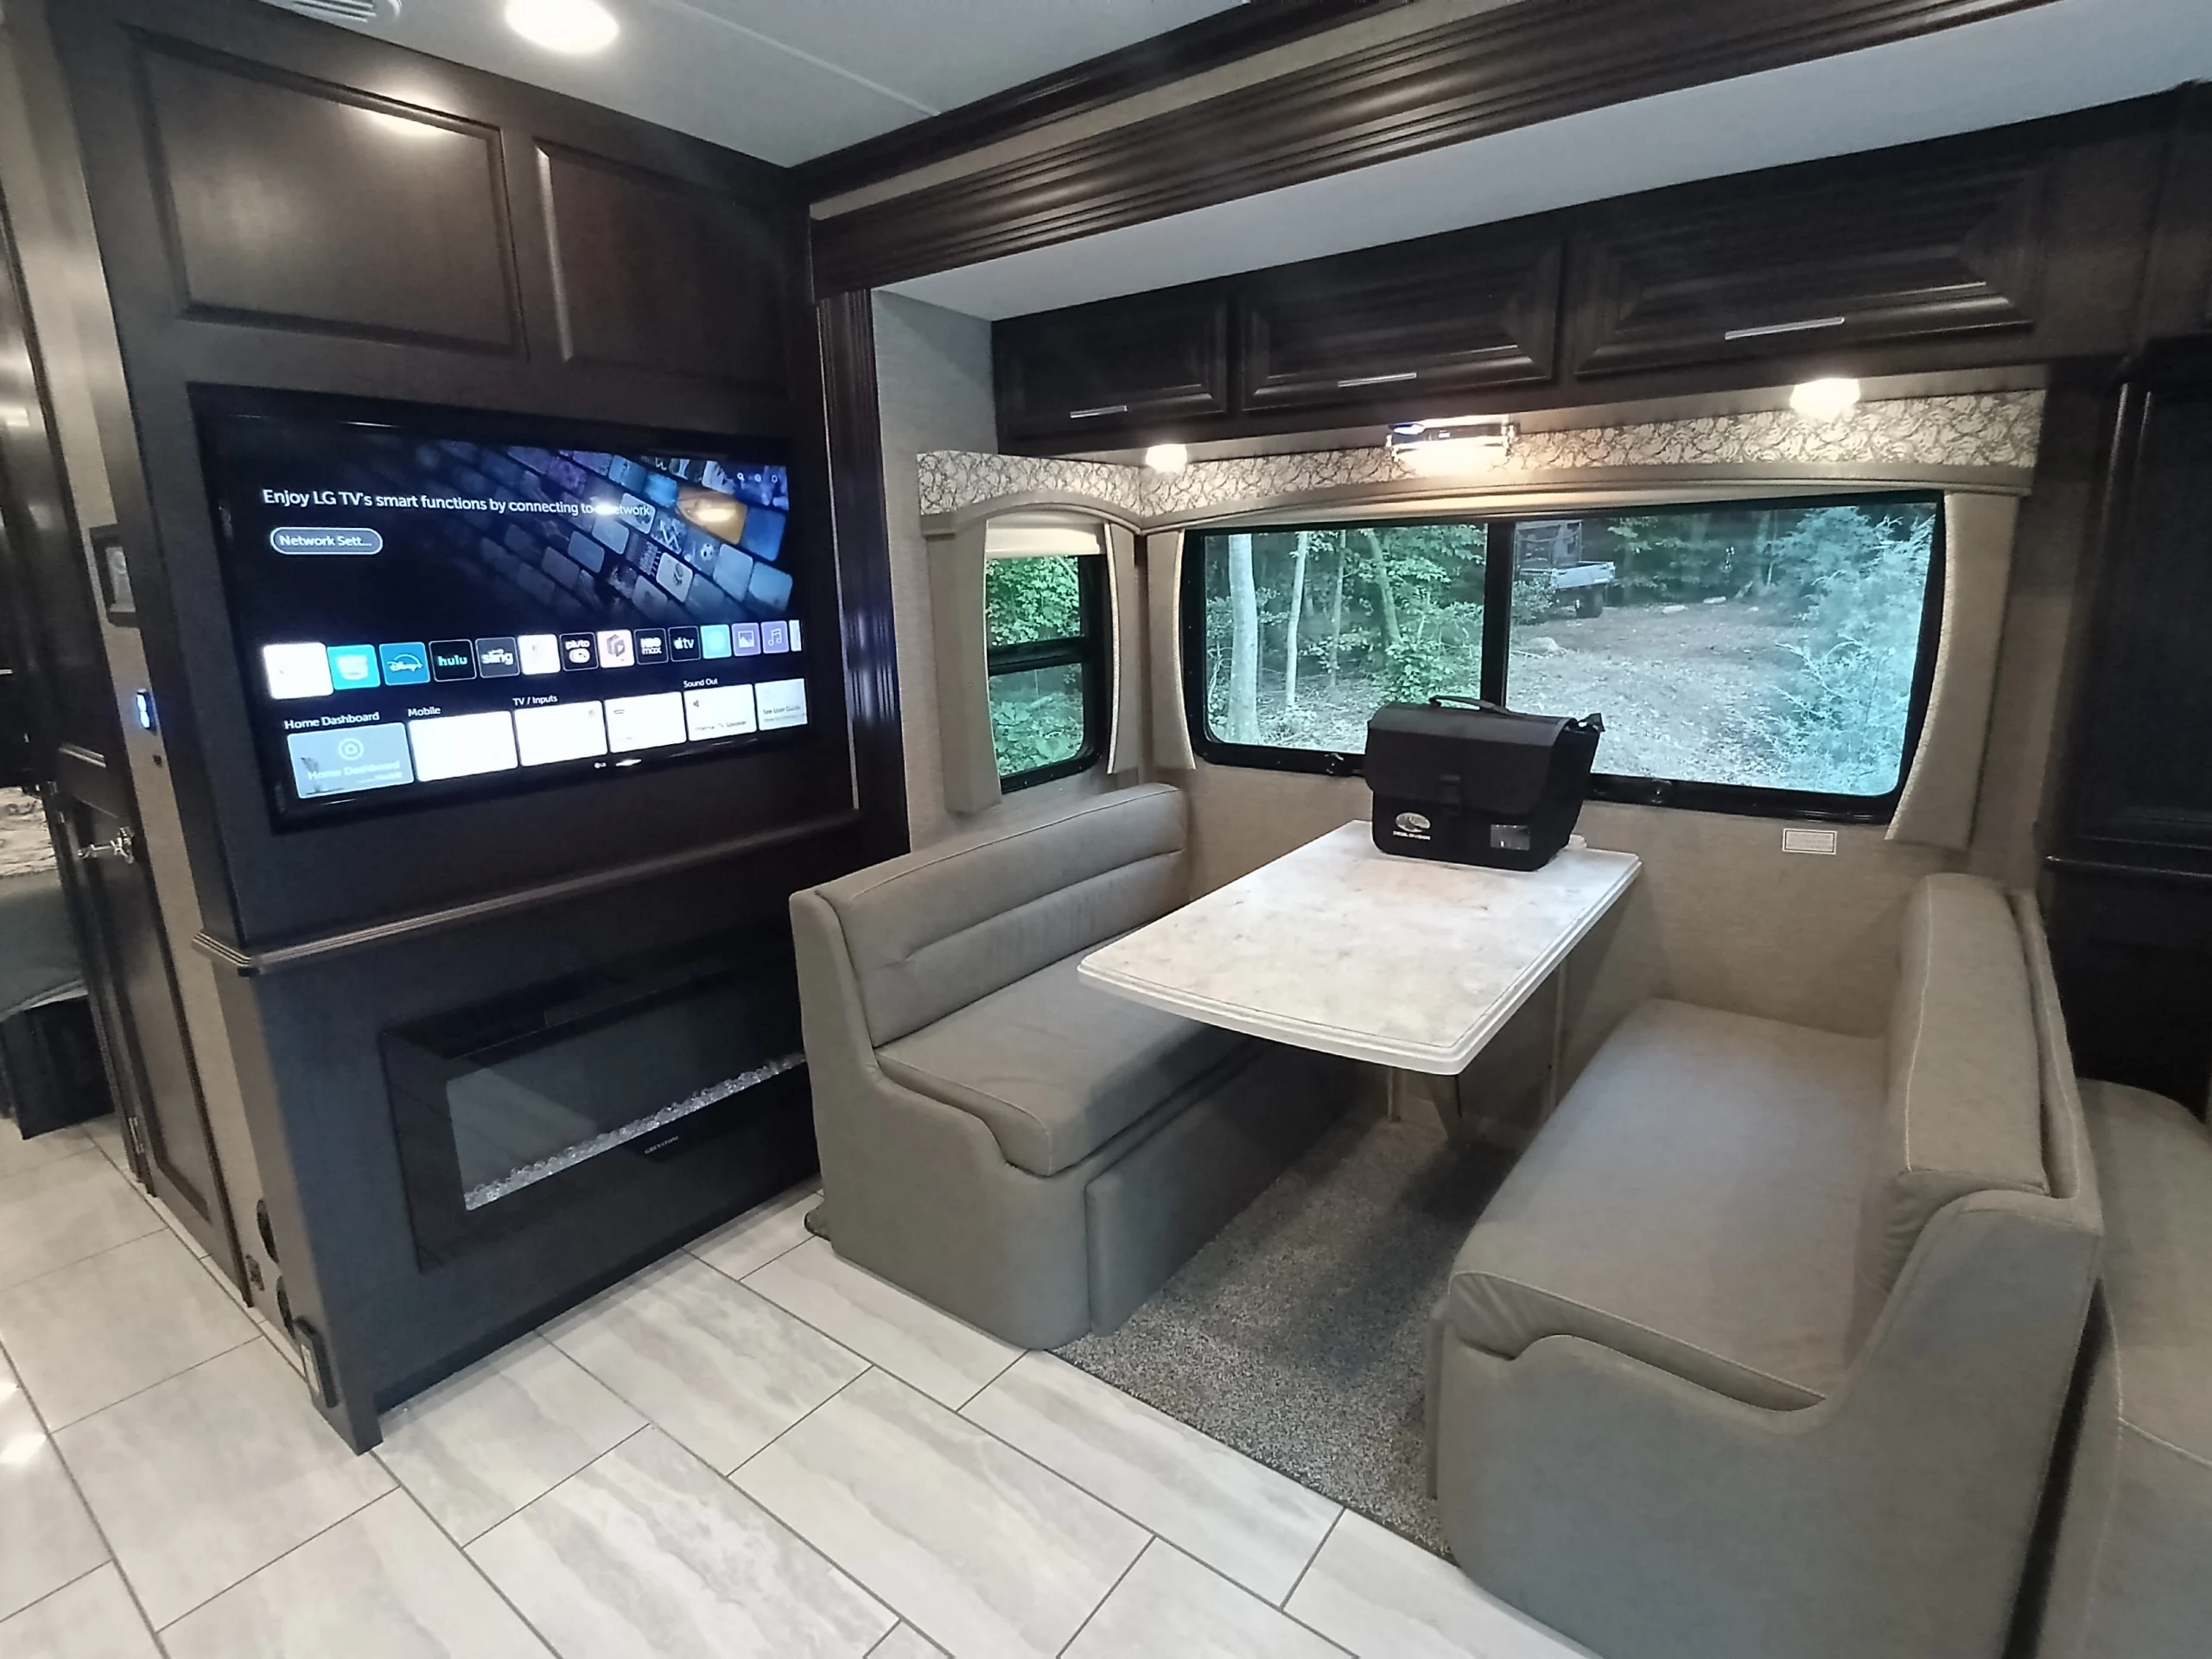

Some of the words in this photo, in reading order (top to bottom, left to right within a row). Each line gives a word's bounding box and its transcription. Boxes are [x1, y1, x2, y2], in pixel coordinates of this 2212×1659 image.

[263, 489, 309, 507] Enjoy
[313, 491, 337, 505] LG
[338, 491, 373, 506] TV's
[376, 495, 418, 508] smart
[421, 495, 488, 511] functions
[489, 498, 506, 514] by
[508, 499, 579, 516] connecting
[581, 502, 594, 513] to
[608, 505, 651, 516] etwork
[279, 534, 335, 546] Network
[437, 655, 468, 667] hulu
[705, 677, 719, 686] Out
[512, 697, 525, 706] TV
[532, 694, 558, 705] Inputs
[408, 706, 442, 717] Mobile
[284, 720, 320, 730] Home
[321, 711, 380, 727] Dashboard
